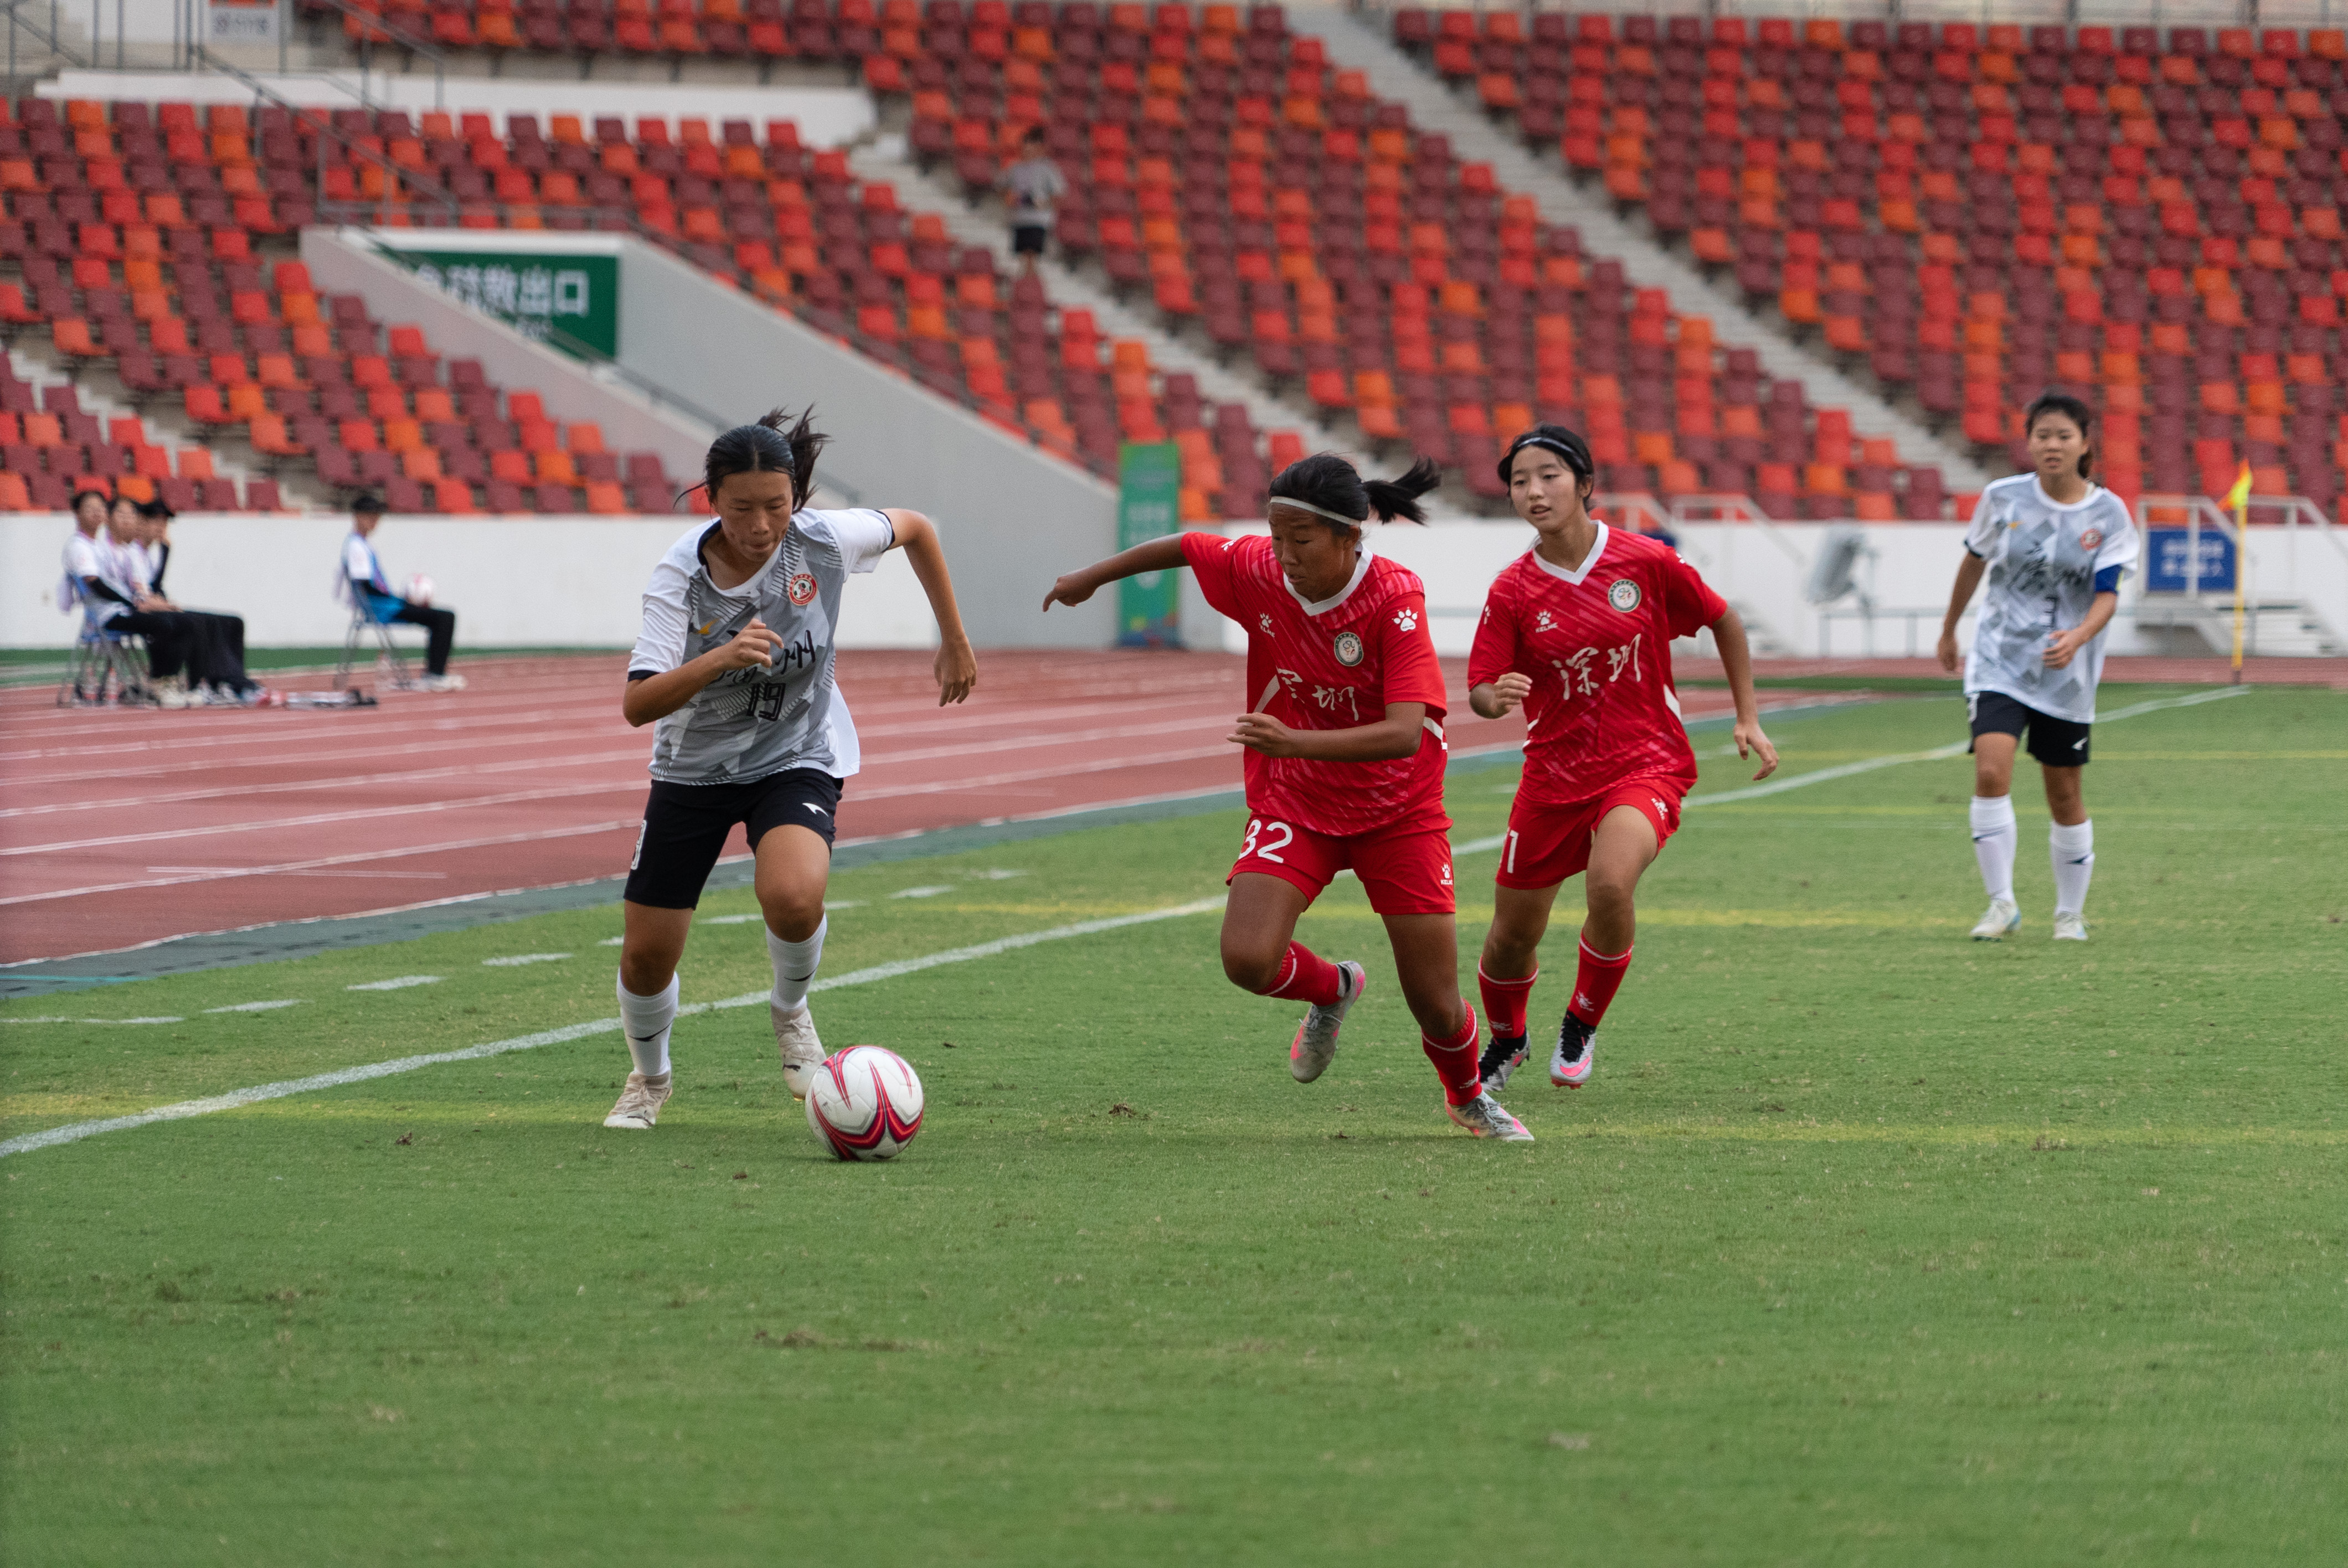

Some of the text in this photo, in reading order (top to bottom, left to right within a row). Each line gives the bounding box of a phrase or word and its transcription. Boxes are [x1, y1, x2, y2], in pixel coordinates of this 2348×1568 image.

[1535, 622, 1558, 633] KELME
[1552, 633, 1642, 700] 深圳
[747, 682, 786, 721] 19
[1238, 819, 1293, 864] 32
